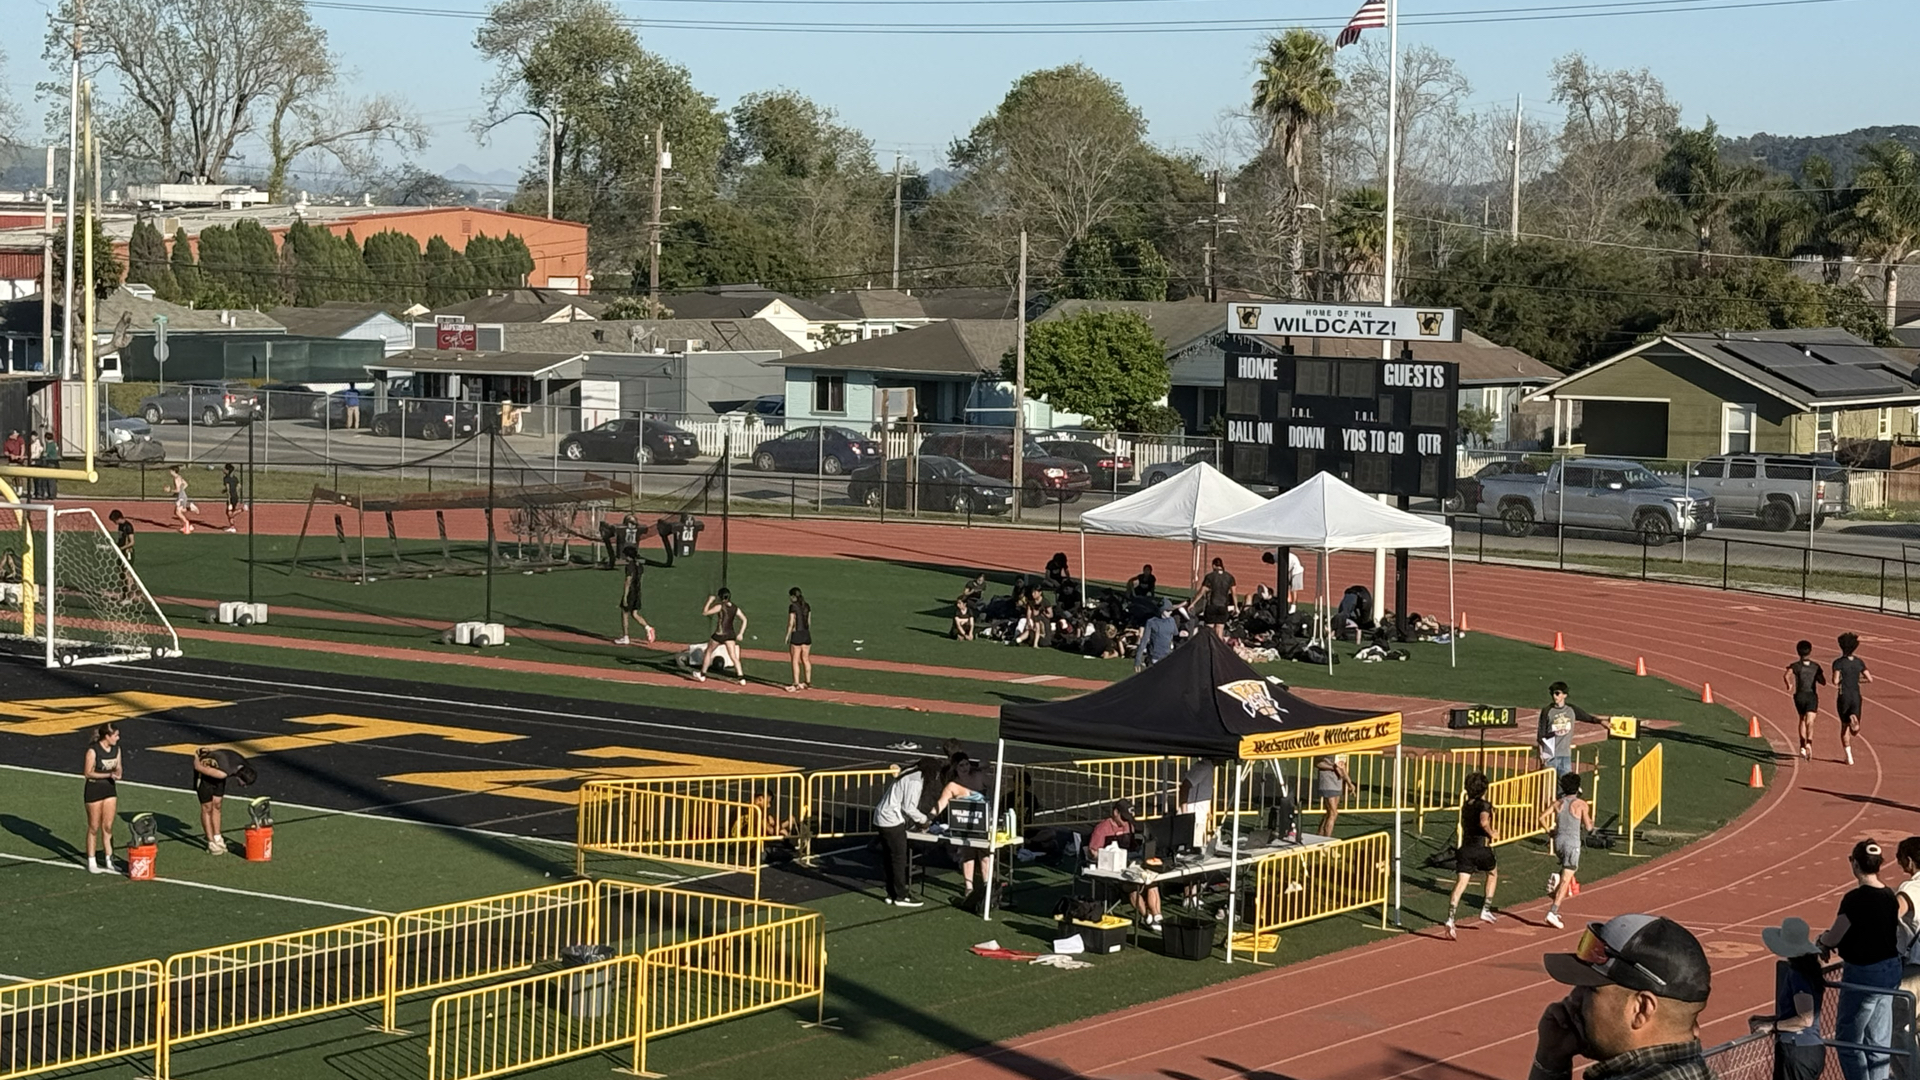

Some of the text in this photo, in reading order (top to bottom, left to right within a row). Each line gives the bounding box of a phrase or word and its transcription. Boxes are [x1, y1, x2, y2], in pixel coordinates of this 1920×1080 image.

[1305, 309, 1332, 317] HOME
[1337, 310, 1349, 318] OF
[1273, 317, 1396, 336] WILDCATZ!
[1238, 357, 1278, 380] HOME
[1384, 363, 1445, 388] GUESTS
[1228, 420, 1274, 444] BALL ON
[1288, 426, 1325, 449] DOWN
[1342, 428, 1404, 454] YDS TO GO
[1417, 433, 1442, 455] QTR
[1467, 709, 1509, 725] 5:44.0
[1619, 720, 1627, 731] 4
